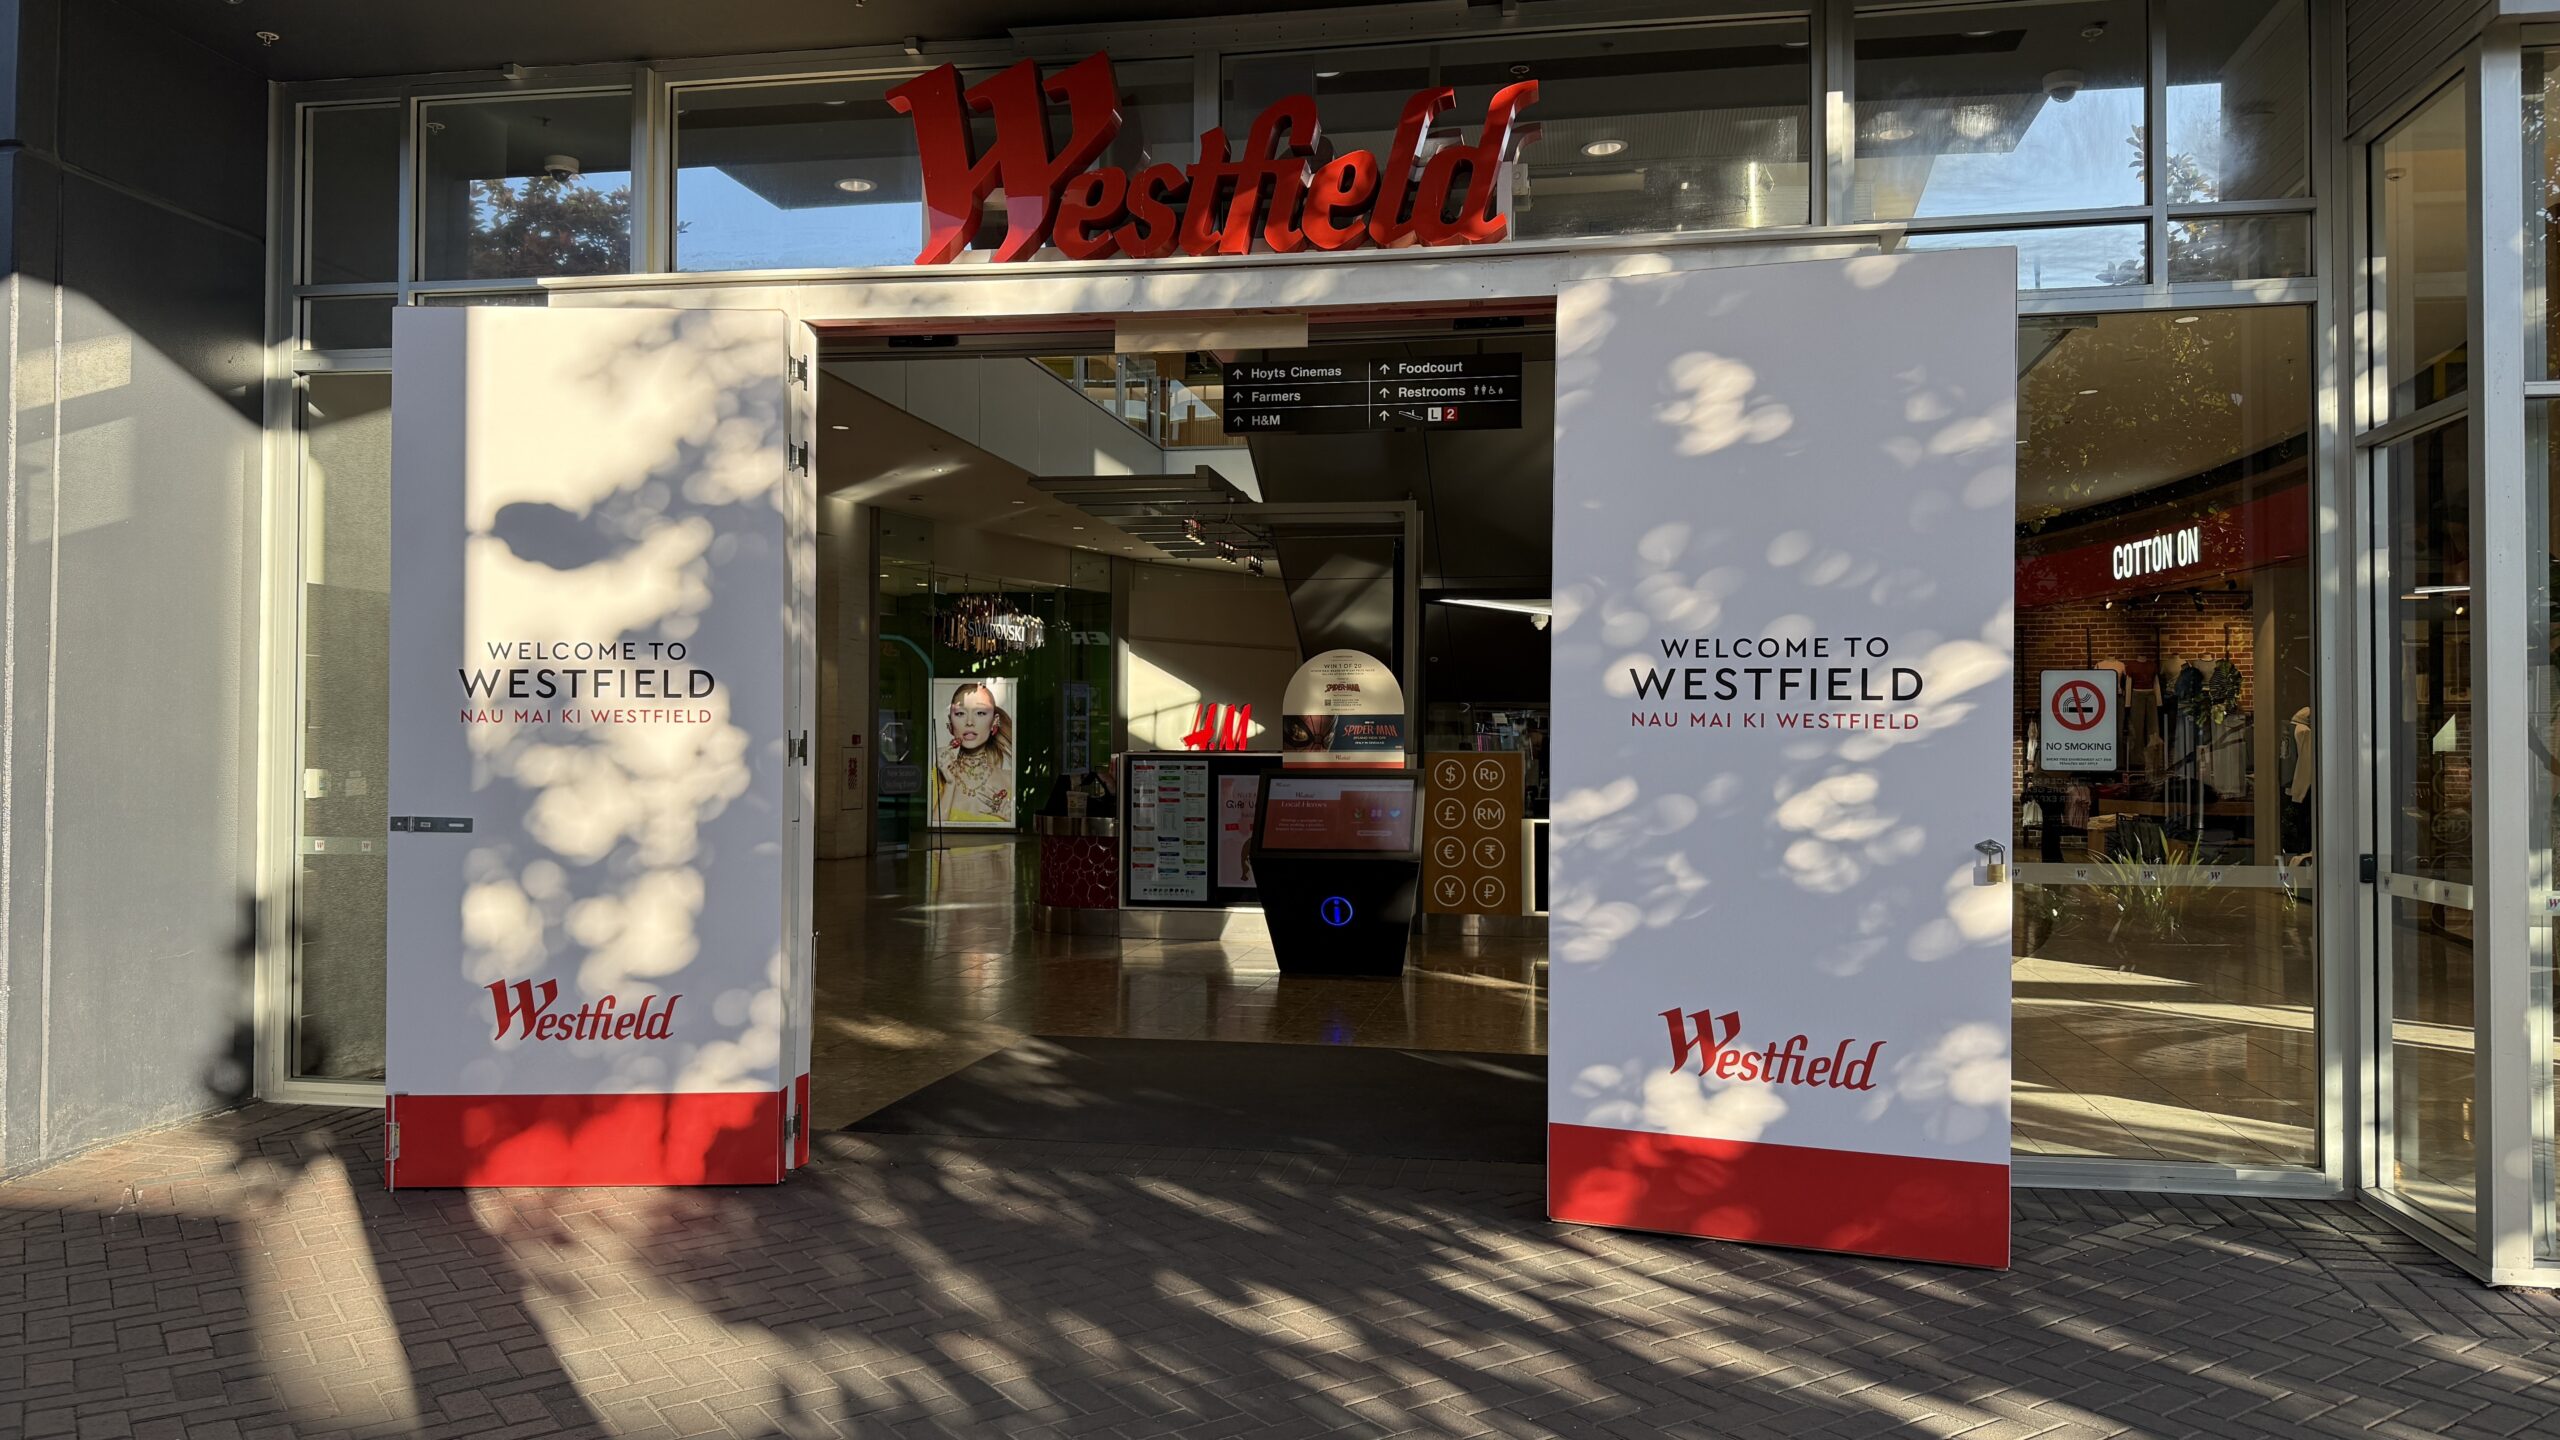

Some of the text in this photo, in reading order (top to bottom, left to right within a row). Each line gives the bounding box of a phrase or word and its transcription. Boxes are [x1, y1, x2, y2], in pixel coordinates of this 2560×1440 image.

[885, 50, 1539, 265] Westfield
[1251, 366, 1342, 380] Hoyts Cinemas
[1399, 361, 1463, 374] Foodcourt
[1251, 391, 1301, 402] Farmers
[1398, 386, 1466, 398] Restrooms
[1251, 414, 1281, 426] H&M
[2113, 526, 2199, 580] COTTON ON
[967, 620, 1025, 641] SWAROVSKI
[487, 642, 687, 660] WELCOME TO
[1660, 637, 1889, 659] WELCOME TO
[458, 668, 715, 699] WESTFIELD
[1629, 668, 1923, 700] WESTFIELD
[460, 709, 712, 723] NAU MAI KI WESTFIELD
[1631, 711, 1919, 730] NAU MAI KI WESTFIELD
[2046, 742, 2112, 751] NO SMOKING
[1480, 767, 1498, 783] Rp
[1477, 807, 1501, 820] RM
[484, 978, 683, 1041] Westfield
[1658, 1007, 1887, 1092] Westfield
